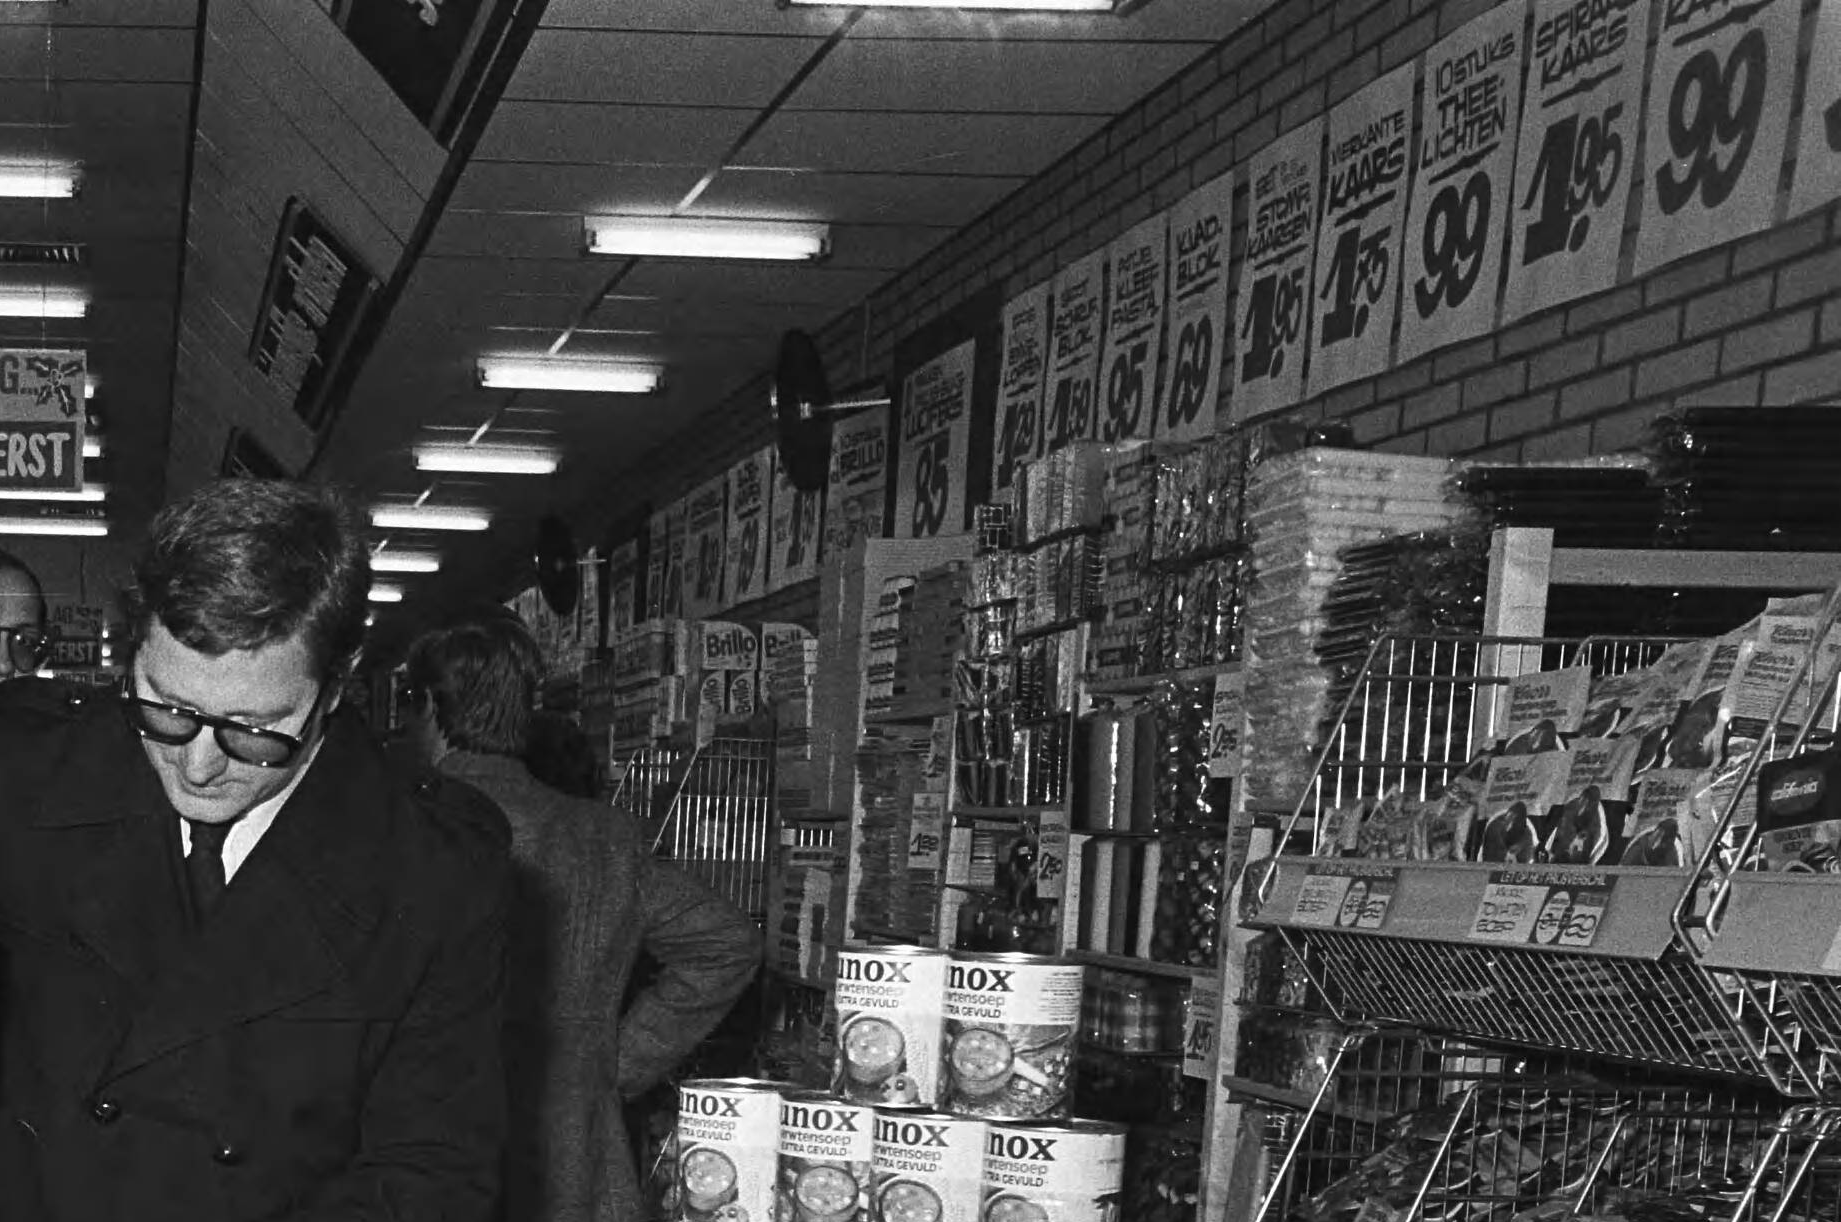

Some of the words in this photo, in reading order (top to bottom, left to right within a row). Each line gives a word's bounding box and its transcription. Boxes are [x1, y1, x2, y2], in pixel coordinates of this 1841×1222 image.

[1540, 14, 1629, 91] KAARS
[1420, 98, 1506, 170] LICHTEN
[1656, 27, 1767, 217] 99
[1327, 136, 1406, 216] KAARS
[1176, 243, 1221, 291] BLOK
[1414, 170, 1492, 320] 99
[1104, 340, 1149, 444] 95
[1167, 313, 1213, 430] 69
[912, 427, 950, 538] 85
[708, 628, 757, 658] Brillo
[949, 964, 1015, 993] nox
[988, 1131, 1058, 1162] nox
